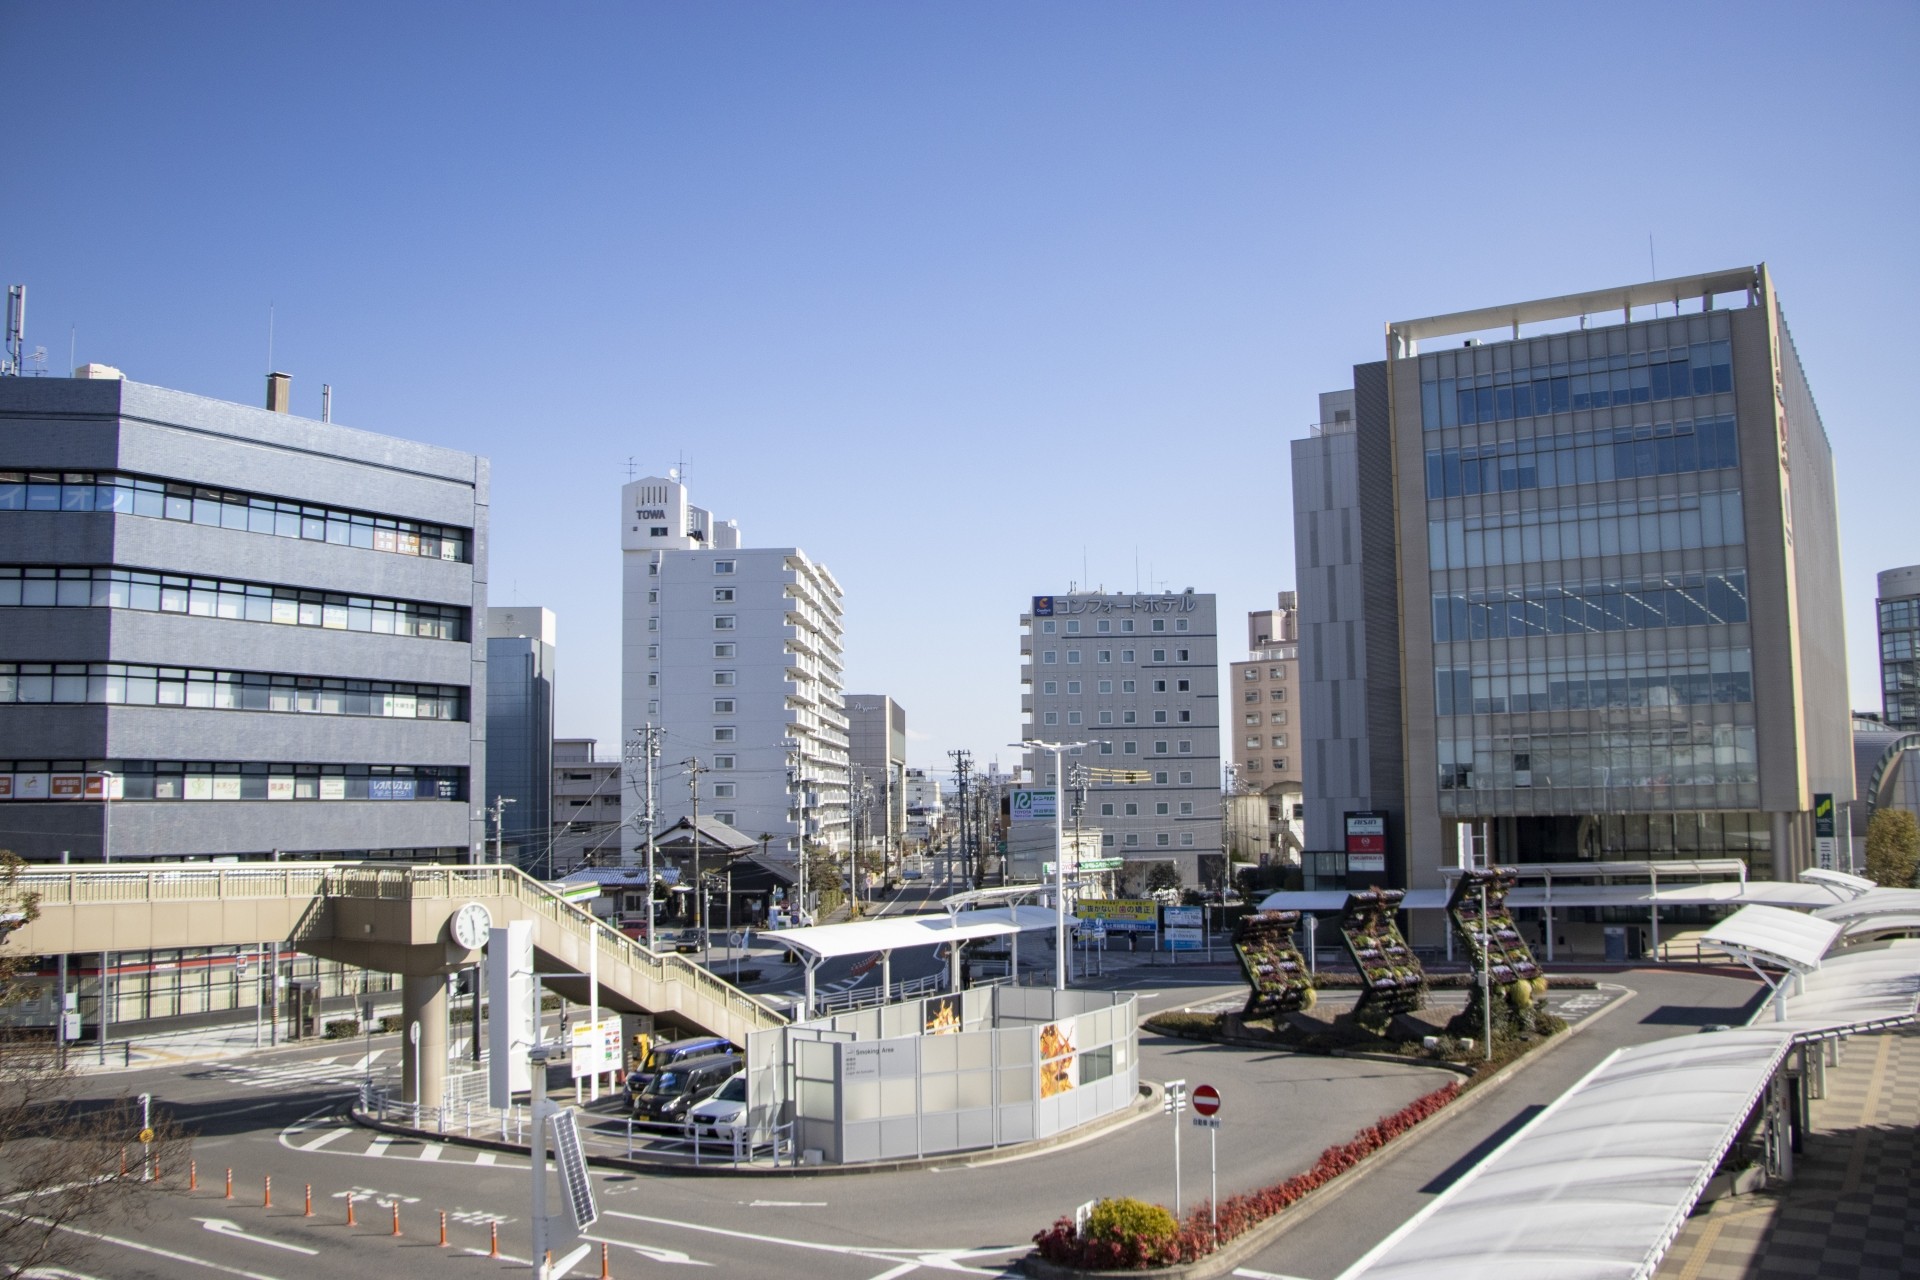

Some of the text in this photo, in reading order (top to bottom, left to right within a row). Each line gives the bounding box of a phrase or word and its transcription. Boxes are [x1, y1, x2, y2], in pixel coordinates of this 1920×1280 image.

[636, 509, 665, 520] TOWA
[1056, 596, 1197, 615] コンフォートホテル
[373, 780, 412, 790] レオパレス21
